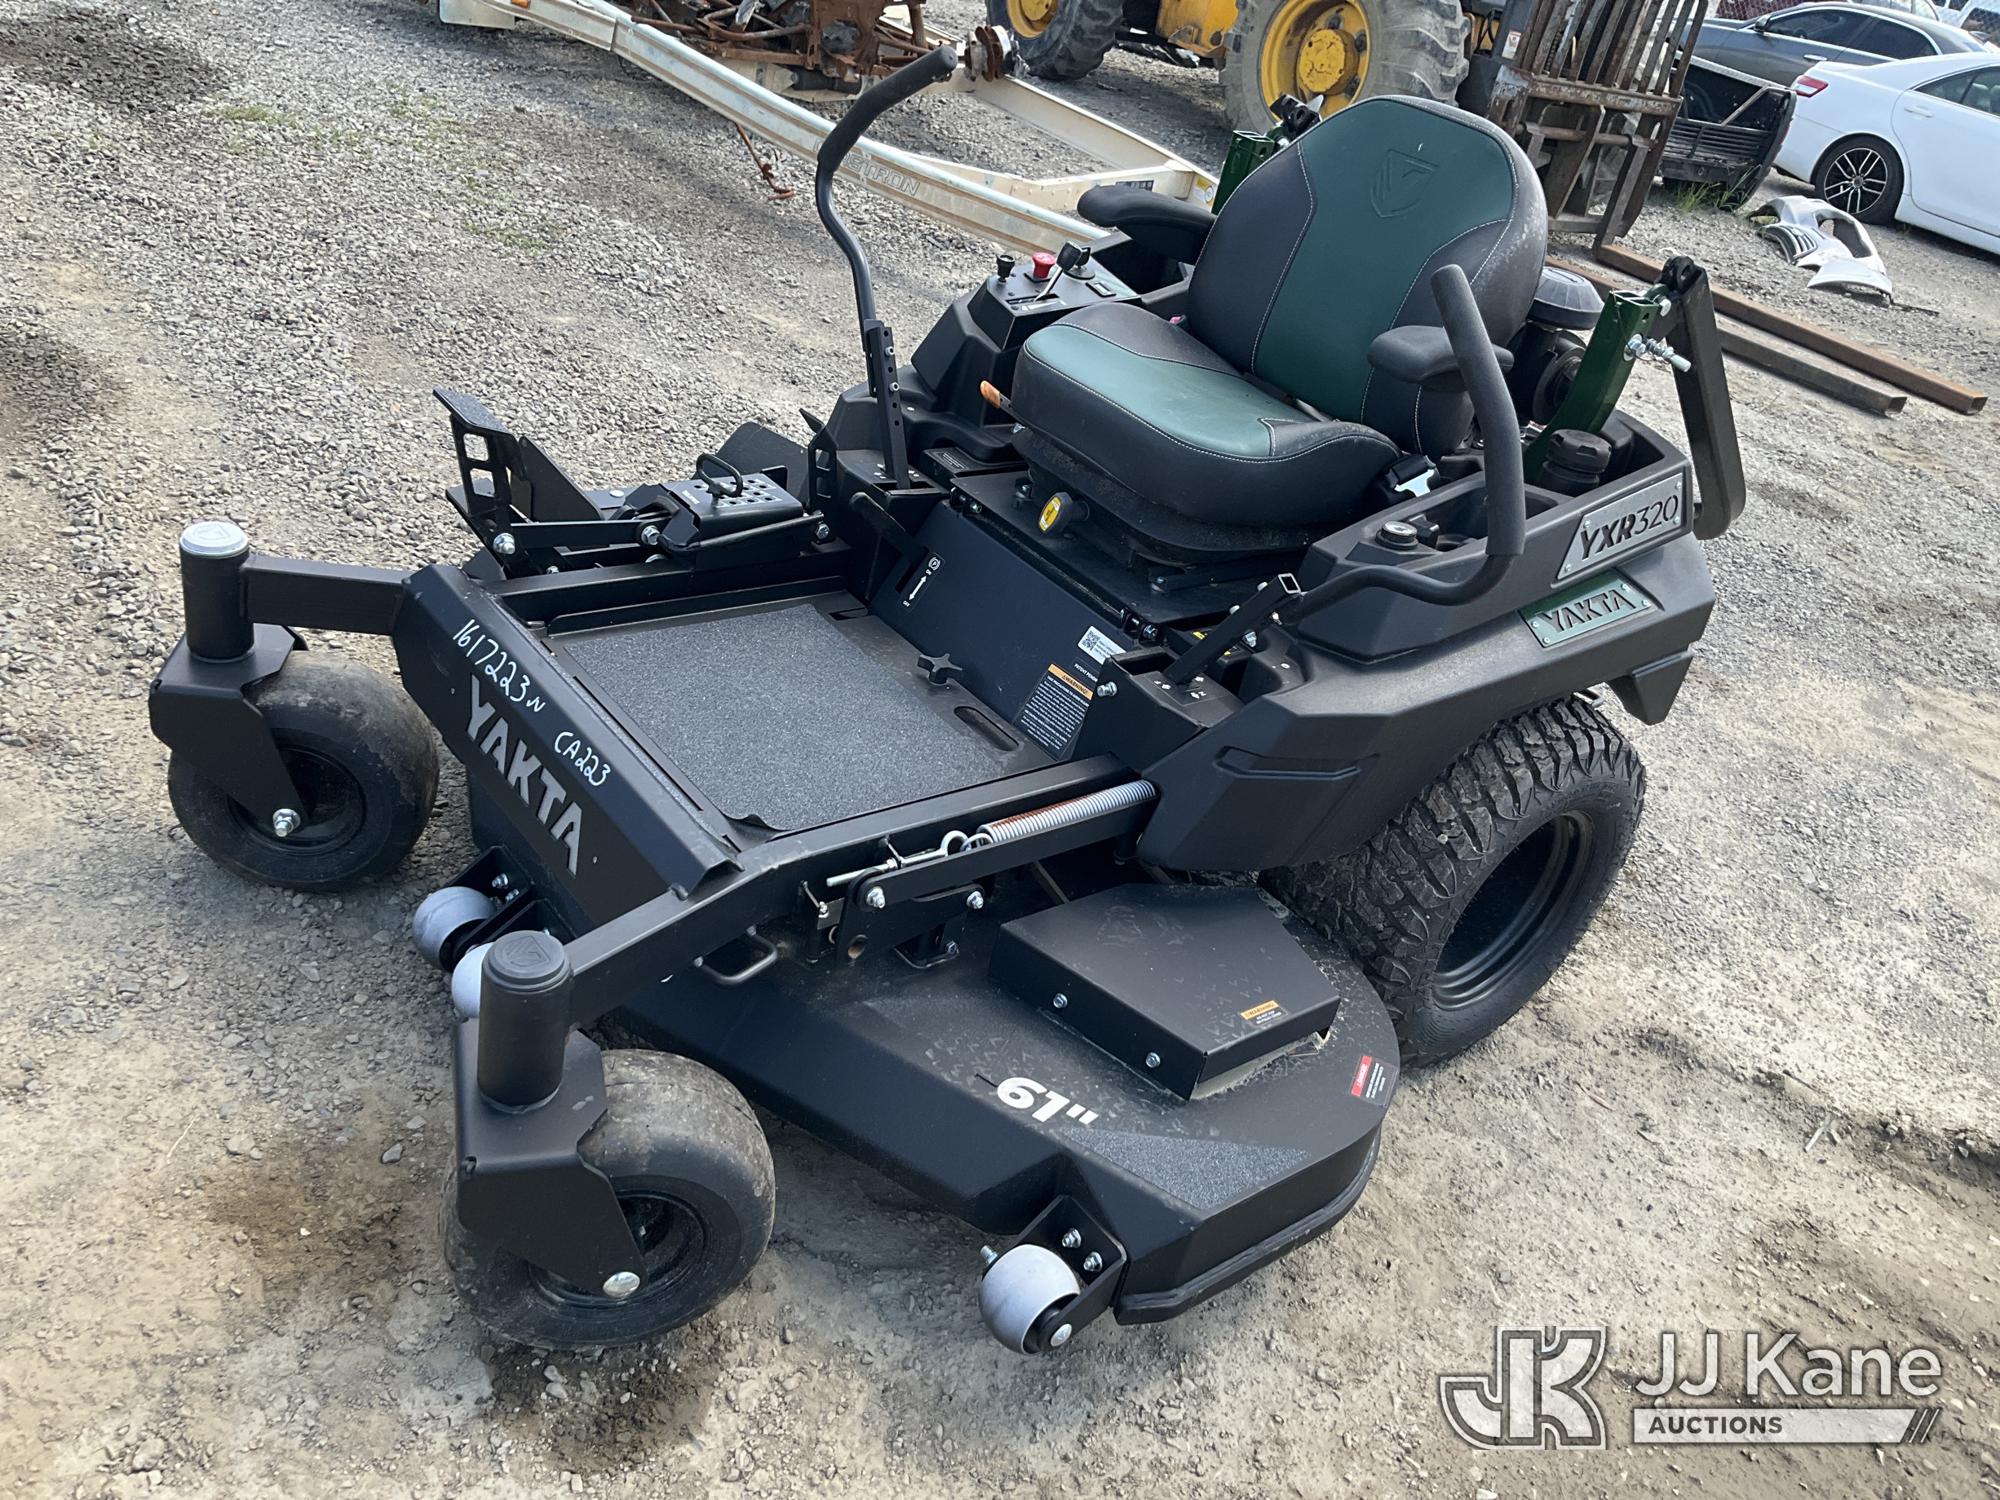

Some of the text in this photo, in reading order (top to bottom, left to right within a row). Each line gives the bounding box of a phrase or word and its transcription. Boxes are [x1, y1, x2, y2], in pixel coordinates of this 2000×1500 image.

[1580, 494, 1679, 561] YXR320
[1535, 588, 1637, 633] YAKTA
[466, 673, 583, 879] YAKTA
[554, 731, 612, 787] CA223
[997, 1076, 1100, 1125] 61"
